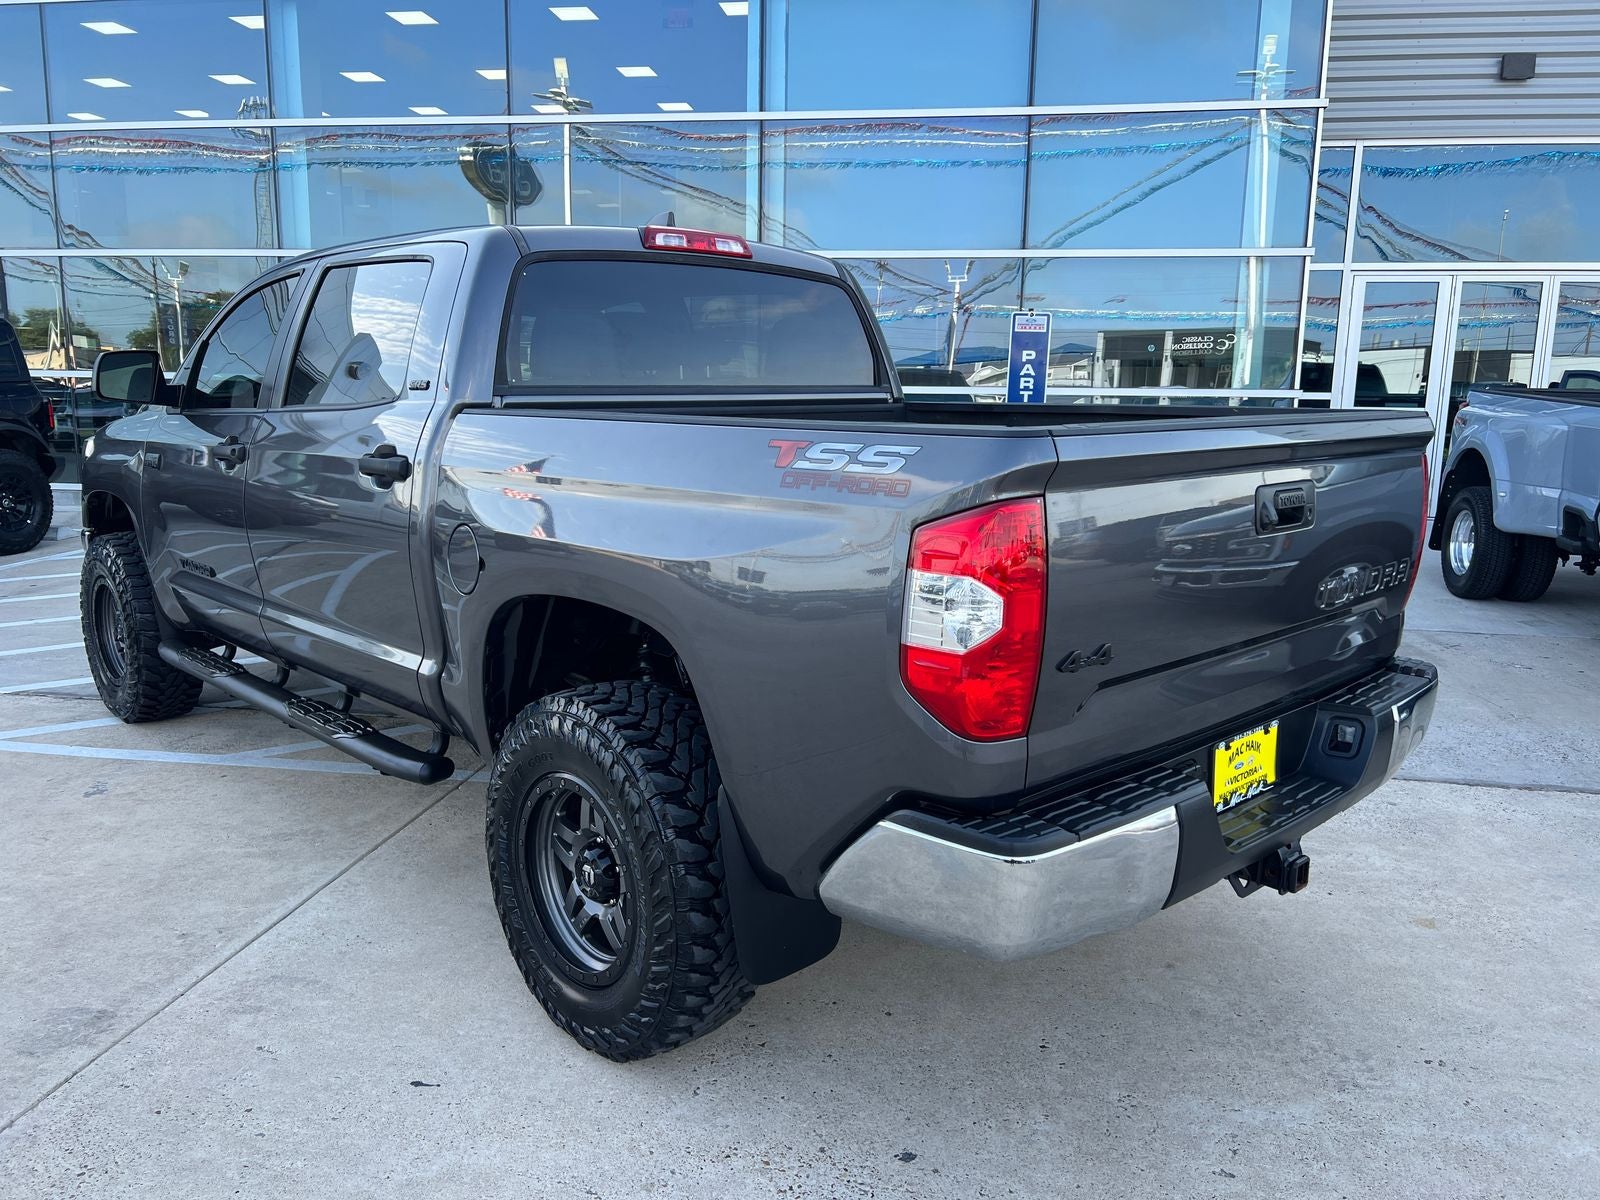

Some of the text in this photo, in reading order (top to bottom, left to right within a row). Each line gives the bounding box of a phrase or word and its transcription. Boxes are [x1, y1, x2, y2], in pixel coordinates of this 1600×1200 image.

[768, 439, 923, 475] TSS
[779, 471, 912, 498] OFF-ROAD
[1278, 493, 1306, 507] TOYOTA
[1316, 557, 1412, 609] TUNDRA
